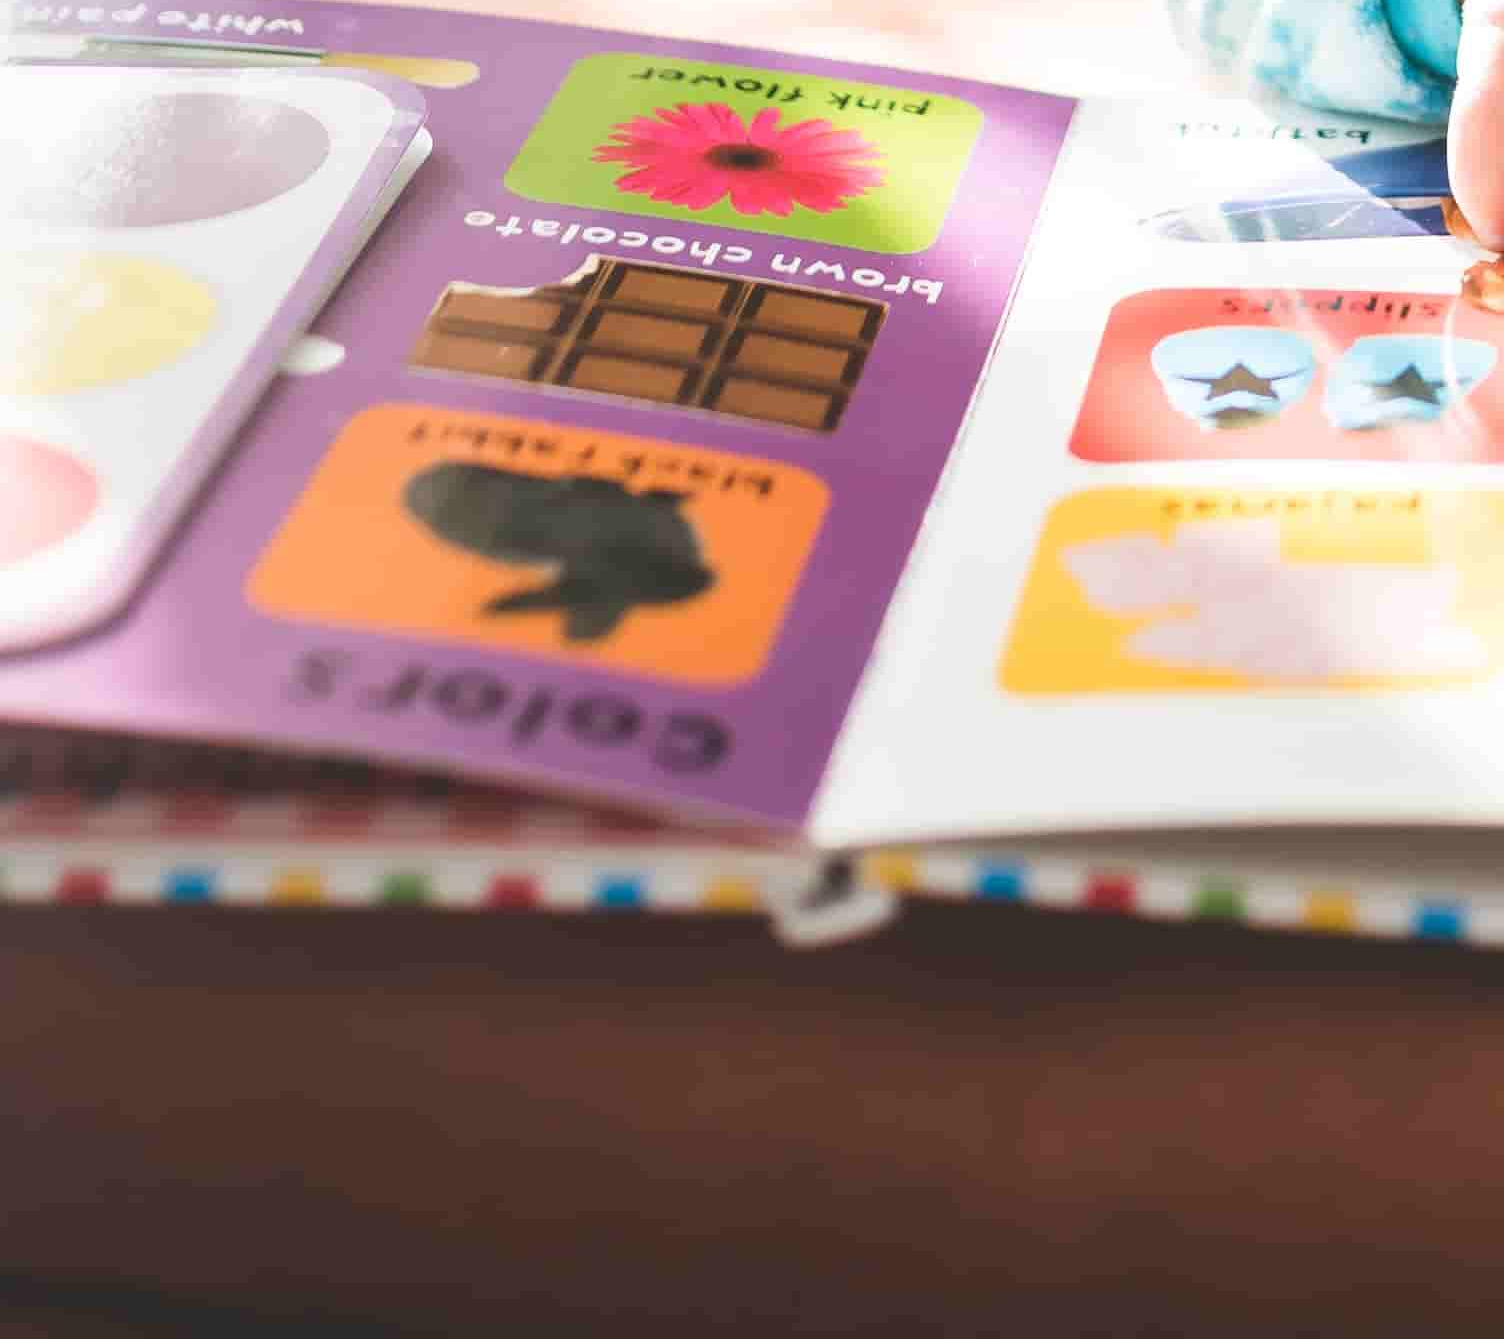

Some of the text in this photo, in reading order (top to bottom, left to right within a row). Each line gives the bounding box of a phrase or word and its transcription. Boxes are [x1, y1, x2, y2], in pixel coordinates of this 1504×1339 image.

[157, 10, 305, 37] white
[626, 66, 933, 119] pink flower
[462, 209, 944, 305] brown chocolate
[1220, 295, 1444, 320] slippers
[401, 421, 776, 503] black rabbit
[282, 649, 732, 777] Colors
